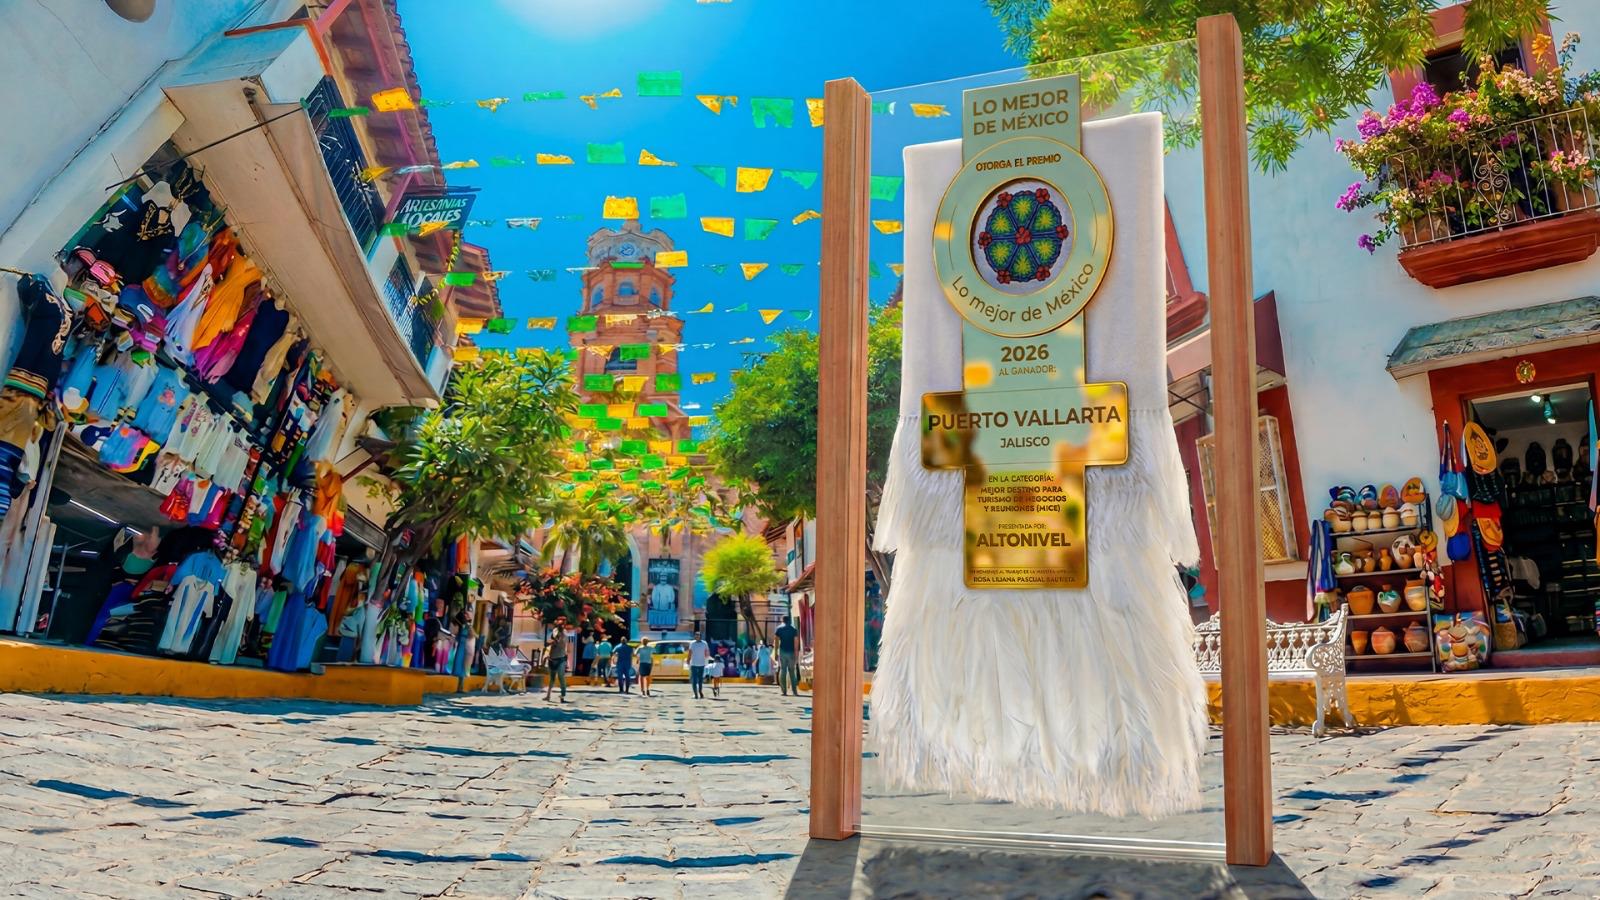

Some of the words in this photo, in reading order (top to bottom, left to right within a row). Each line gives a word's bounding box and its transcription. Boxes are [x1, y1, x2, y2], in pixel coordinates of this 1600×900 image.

[973, 99, 997, 117] LO
[1002, 89, 1069, 113] MEJOR
[973, 120, 997, 136] DE
[1001, 110, 1069, 132] MÉXICO
[975, 159, 1012, 172] OTORGA
[1014, 158, 1024, 168] EL
[1026, 153, 1062, 166] PREMIO
[402, 209, 462, 228] LOCALES
[952, 275, 969, 298] Lo
[969, 296, 1016, 322] mejor
[1021, 306, 1042, 322] de
[1045, 263, 1093, 315] México
[1001, 344, 1049, 362] 2026
[999, 367, 1009, 376] AL
[1011, 364, 1056, 376] GANADOR:
[928, 411, 1009, 431] PUERTO
[1013, 406, 1121, 427] VALLARTA
[1000, 436, 1050, 448] JALISCO
[981, 487, 1005, 495] MEJOR
[1037, 504, 1061, 512] (MICE)
[976, 533, 1071, 547] ALTONIVEL
